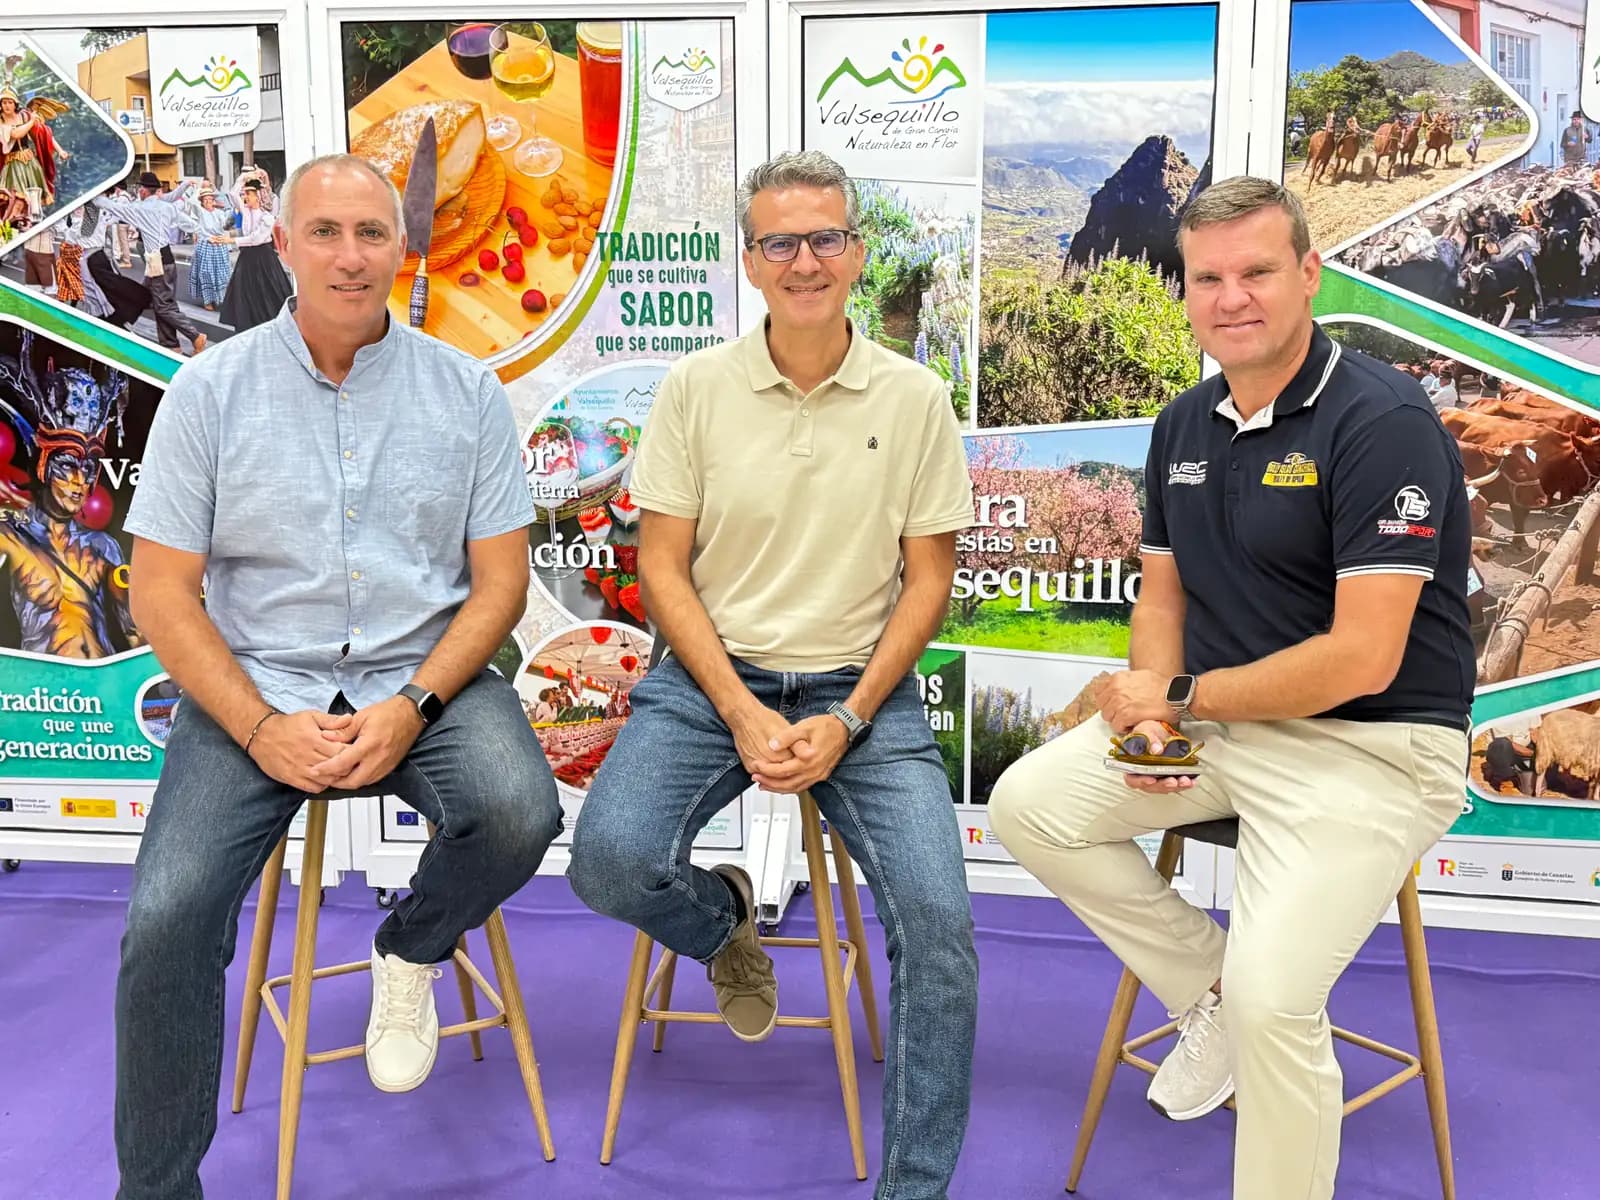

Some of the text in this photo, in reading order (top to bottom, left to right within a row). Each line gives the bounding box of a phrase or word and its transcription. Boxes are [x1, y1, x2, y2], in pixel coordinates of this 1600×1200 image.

[161, 94, 249, 118] Valsequillo
[820, 100, 959, 136] Valsequillo
[845, 129, 959, 150] Naturaleza en Flor
[905, 125, 925, 134] Gran
[928, 126, 959, 134] Canaria
[596, 221, 720, 262] TRADICIÓN
[607, 266, 707, 288] que se cultiva
[620, 291, 713, 327] SABOR
[595, 335, 624, 357] que
[628, 336, 646, 352] se
[1025, 536, 1059, 554] en
[42, 718, 114, 735] que une
[129, 802, 145, 818] TR
[967, 827, 983, 844] TR
[1437, 858, 1456, 877] TR
